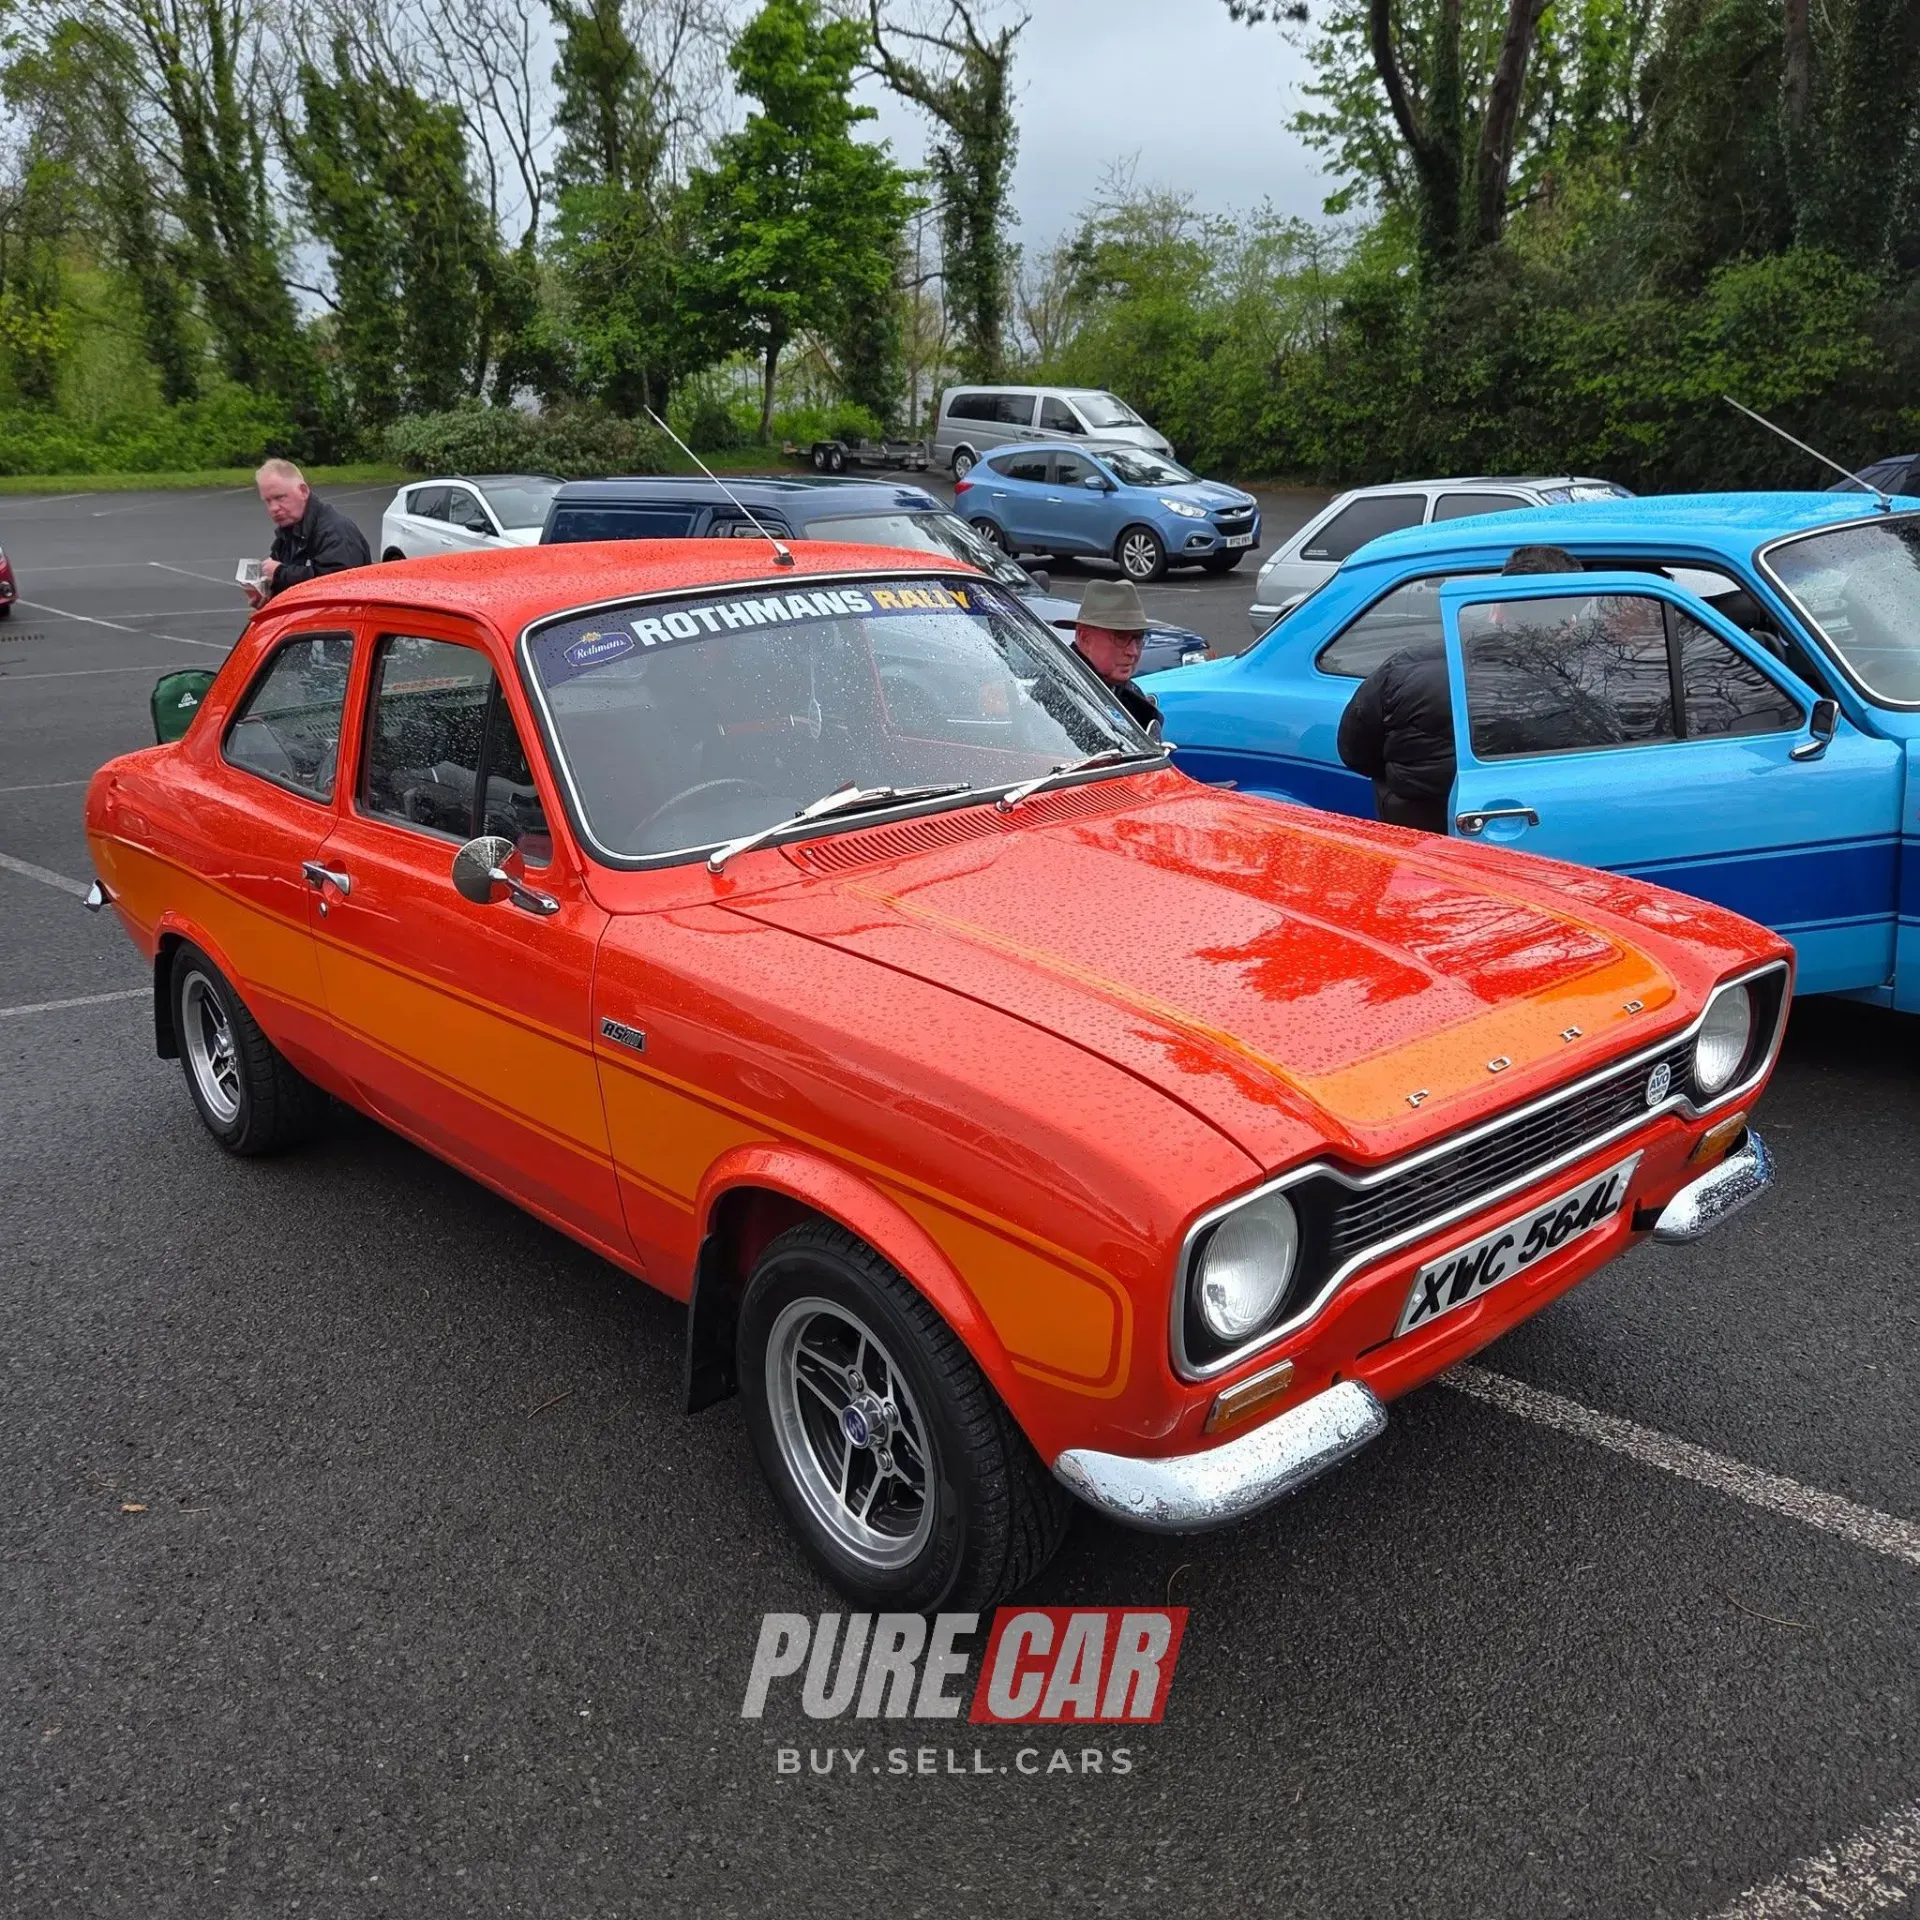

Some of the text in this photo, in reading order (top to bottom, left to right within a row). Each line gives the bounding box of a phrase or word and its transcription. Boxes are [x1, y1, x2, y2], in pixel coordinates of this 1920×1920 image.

[630, 590, 873, 646] ROTHMANS
[871, 588, 970, 609] RALLY
[1405, 999, 1645, 1108] FORD
[1650, 1072, 1669, 1090] AVO
[1408, 1172, 1620, 1325] XWC 564L
